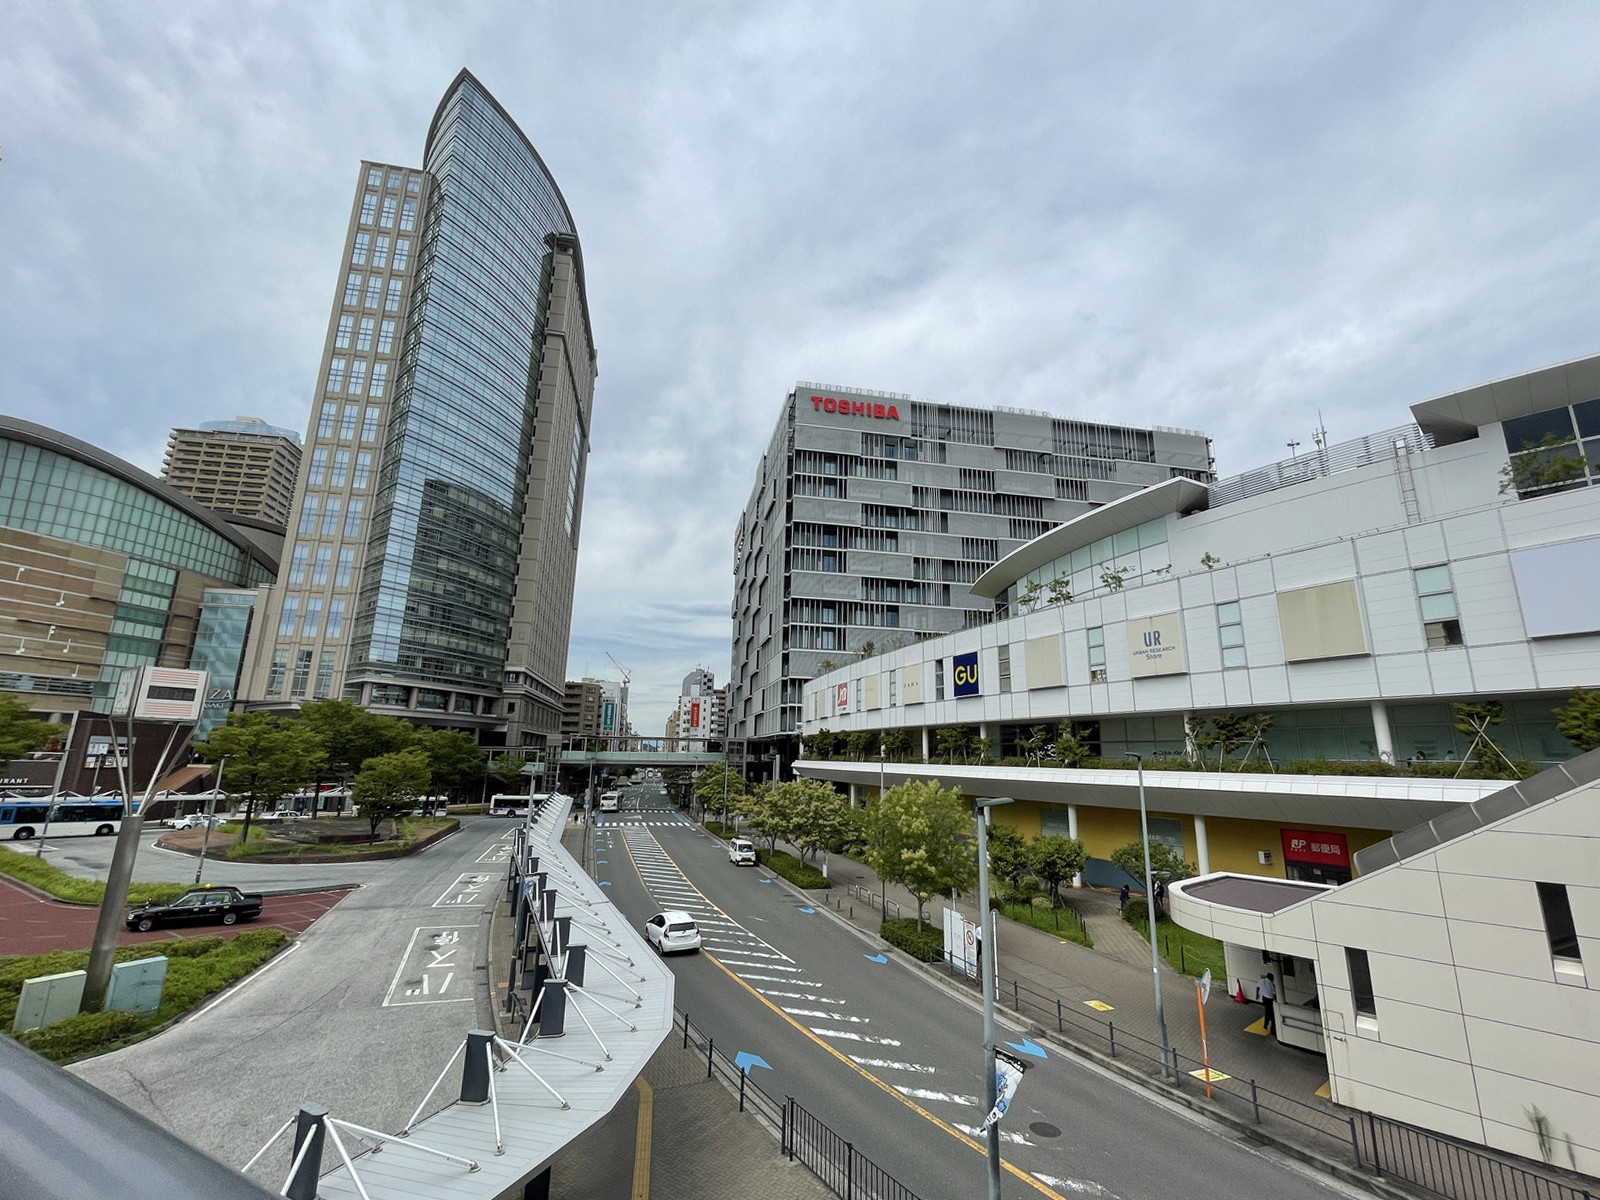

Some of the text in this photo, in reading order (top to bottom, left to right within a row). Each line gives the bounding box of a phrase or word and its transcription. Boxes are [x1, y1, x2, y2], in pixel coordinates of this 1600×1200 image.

[811, 396, 899, 421] TOSHIBA
[1143, 630, 1162, 647] UR
[955, 664, 978, 686] GU
[1291, 839, 1306, 848] JP
[1311, 843, 1341, 855] 郵便局
[405, 930, 460, 996] バス停
